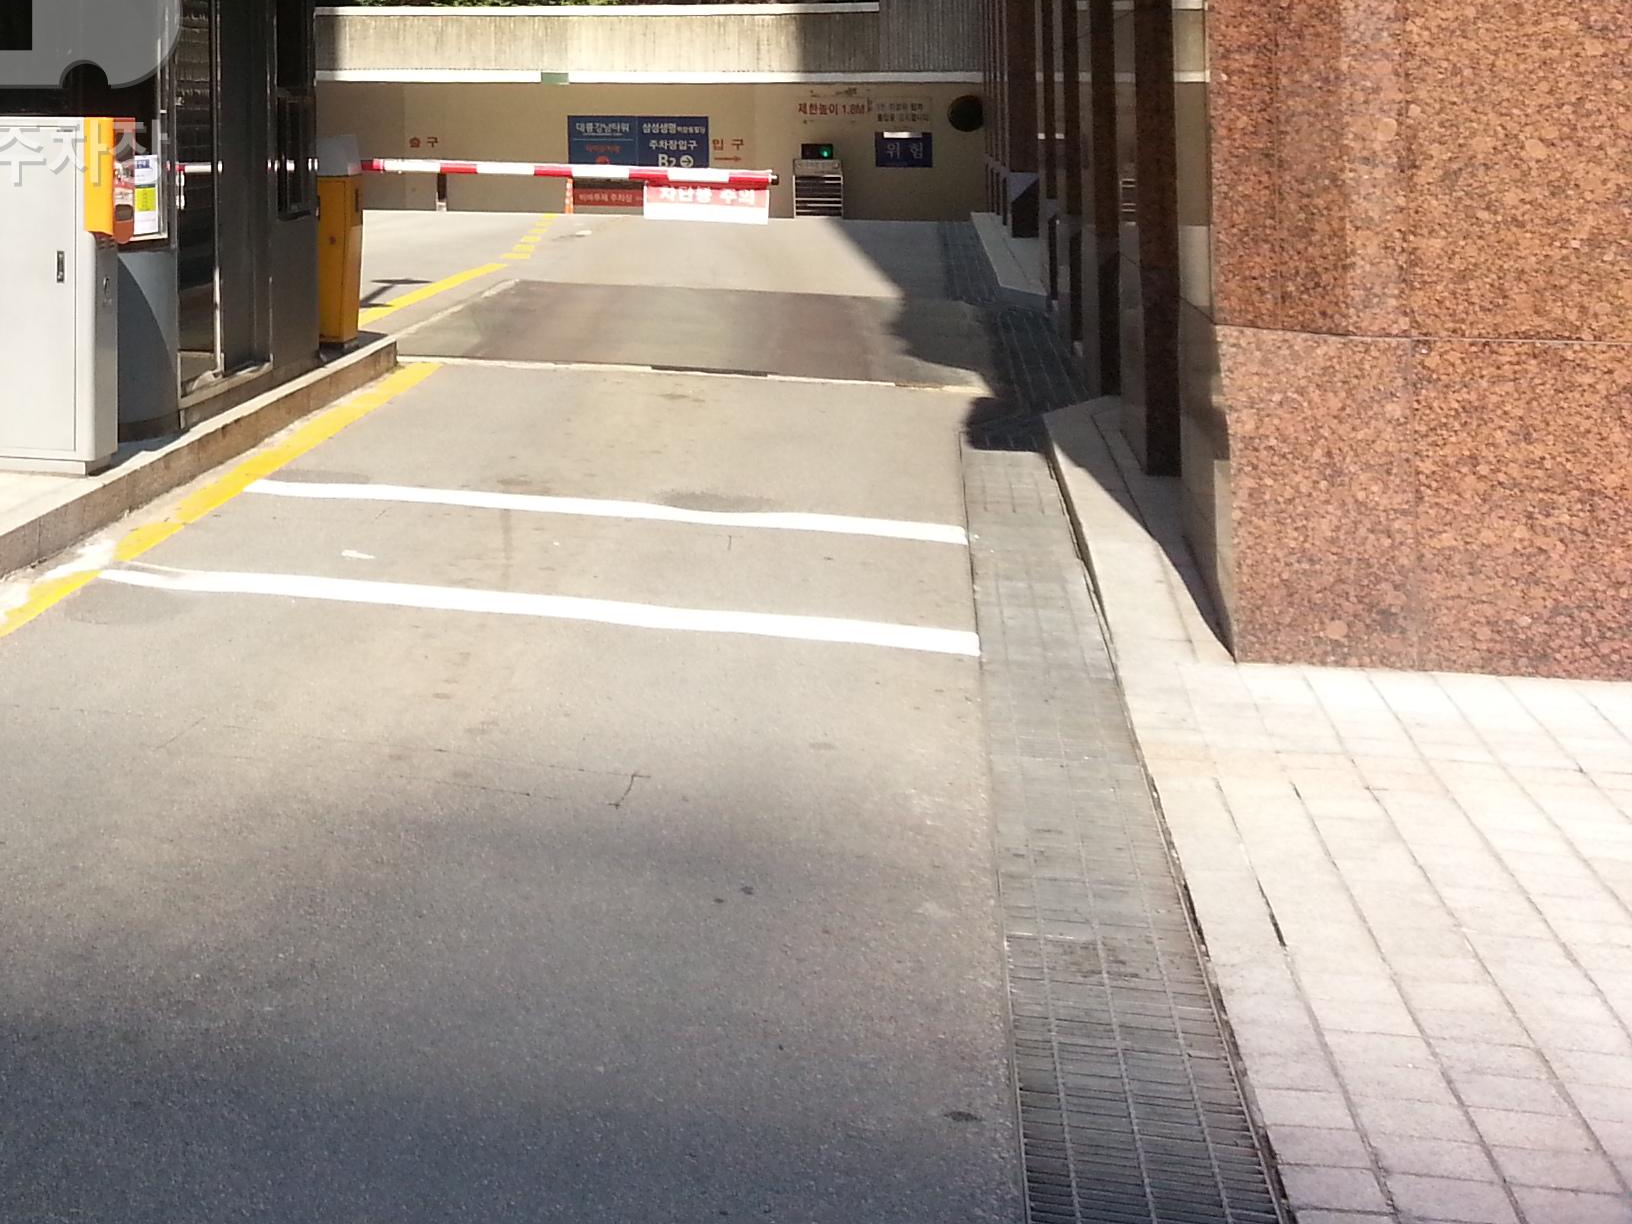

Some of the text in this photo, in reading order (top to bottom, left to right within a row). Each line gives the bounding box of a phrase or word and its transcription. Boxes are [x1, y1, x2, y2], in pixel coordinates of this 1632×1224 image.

[798, 102, 838, 116] 제한높이
[649, 139, 697, 151] 주차장입구
[712, 138, 744, 151] 입구
[885, 141, 924, 160] 위험
[658, 154, 677, 167] B2
